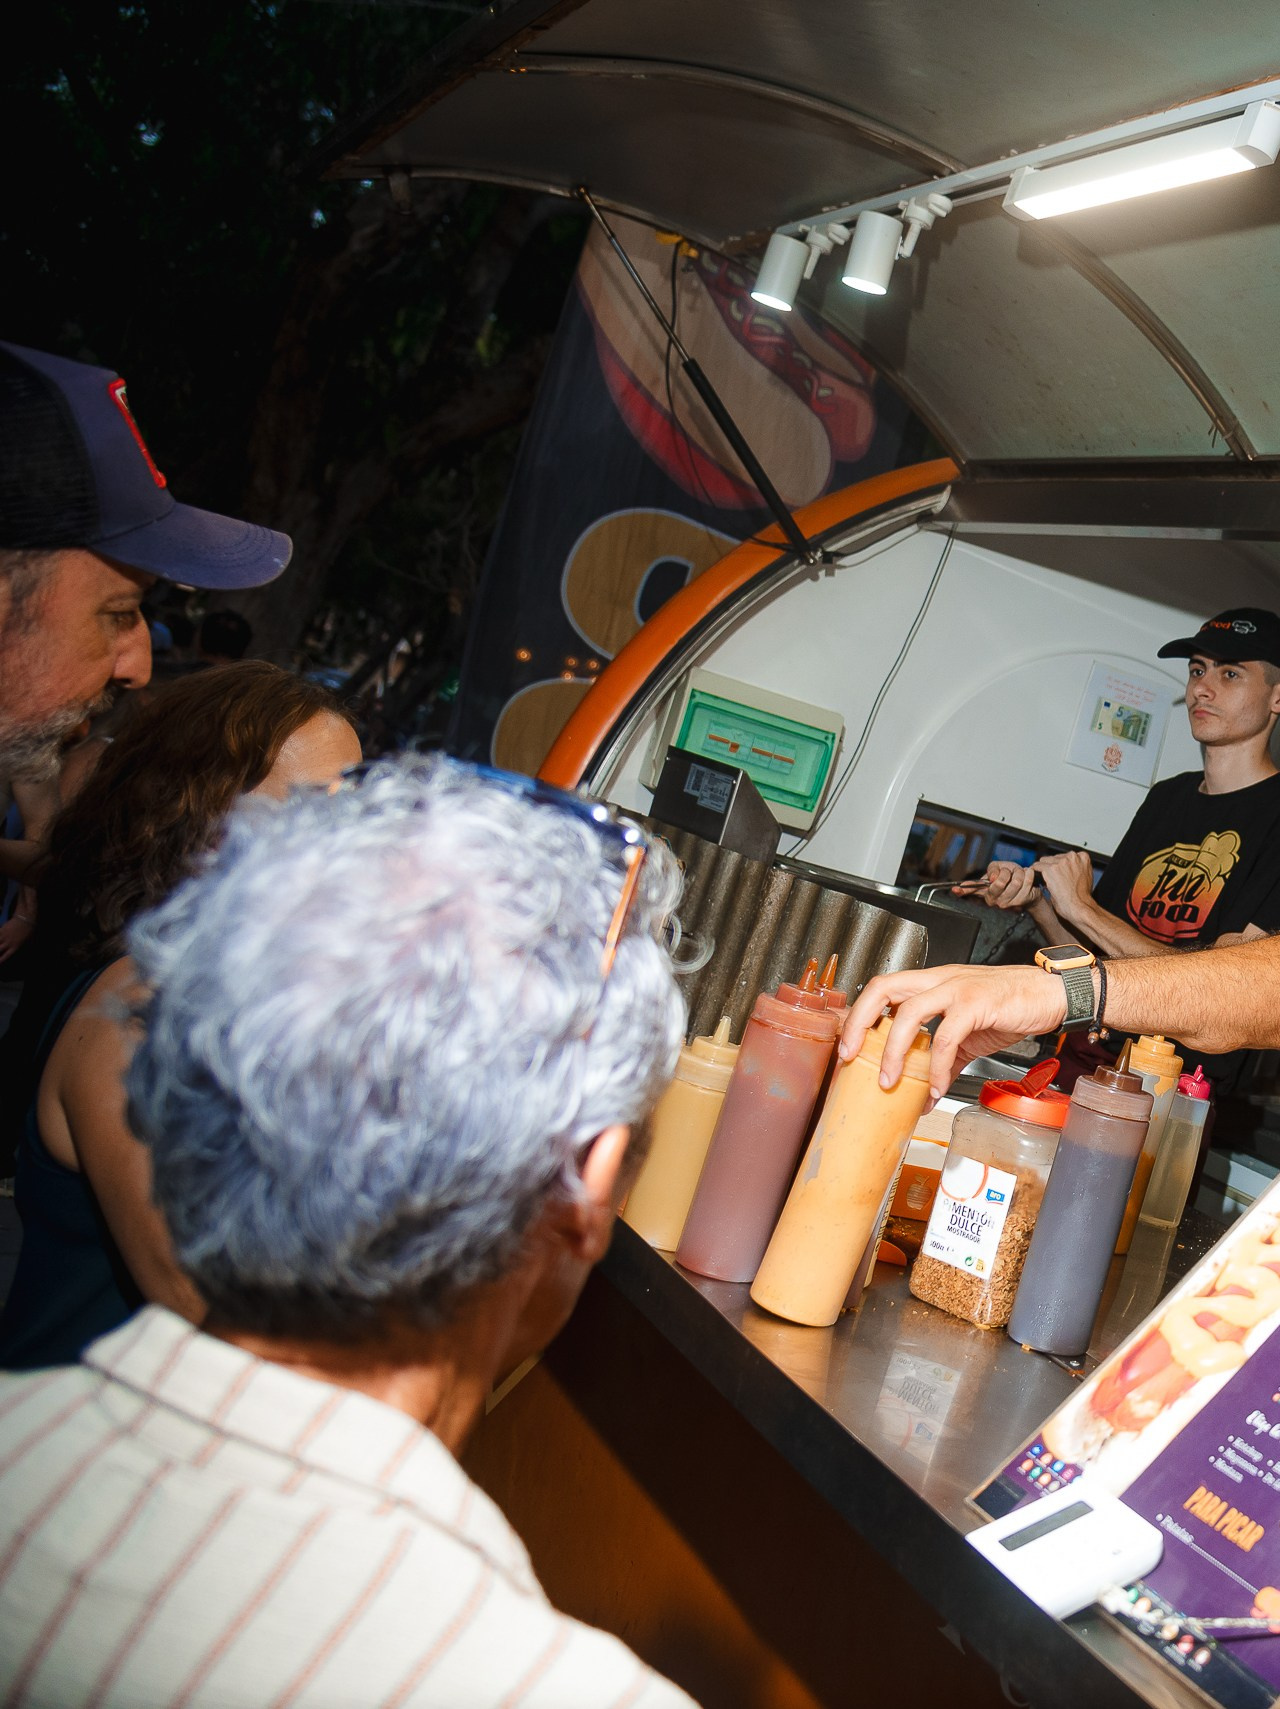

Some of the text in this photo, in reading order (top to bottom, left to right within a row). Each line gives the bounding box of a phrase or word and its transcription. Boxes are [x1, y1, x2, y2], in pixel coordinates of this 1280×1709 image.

[947, 1226, 980, 1244] MOSTRADOR
[950, 1214, 982, 1236] DULCE
[1184, 1487, 1263, 1550] PARA PICAR
